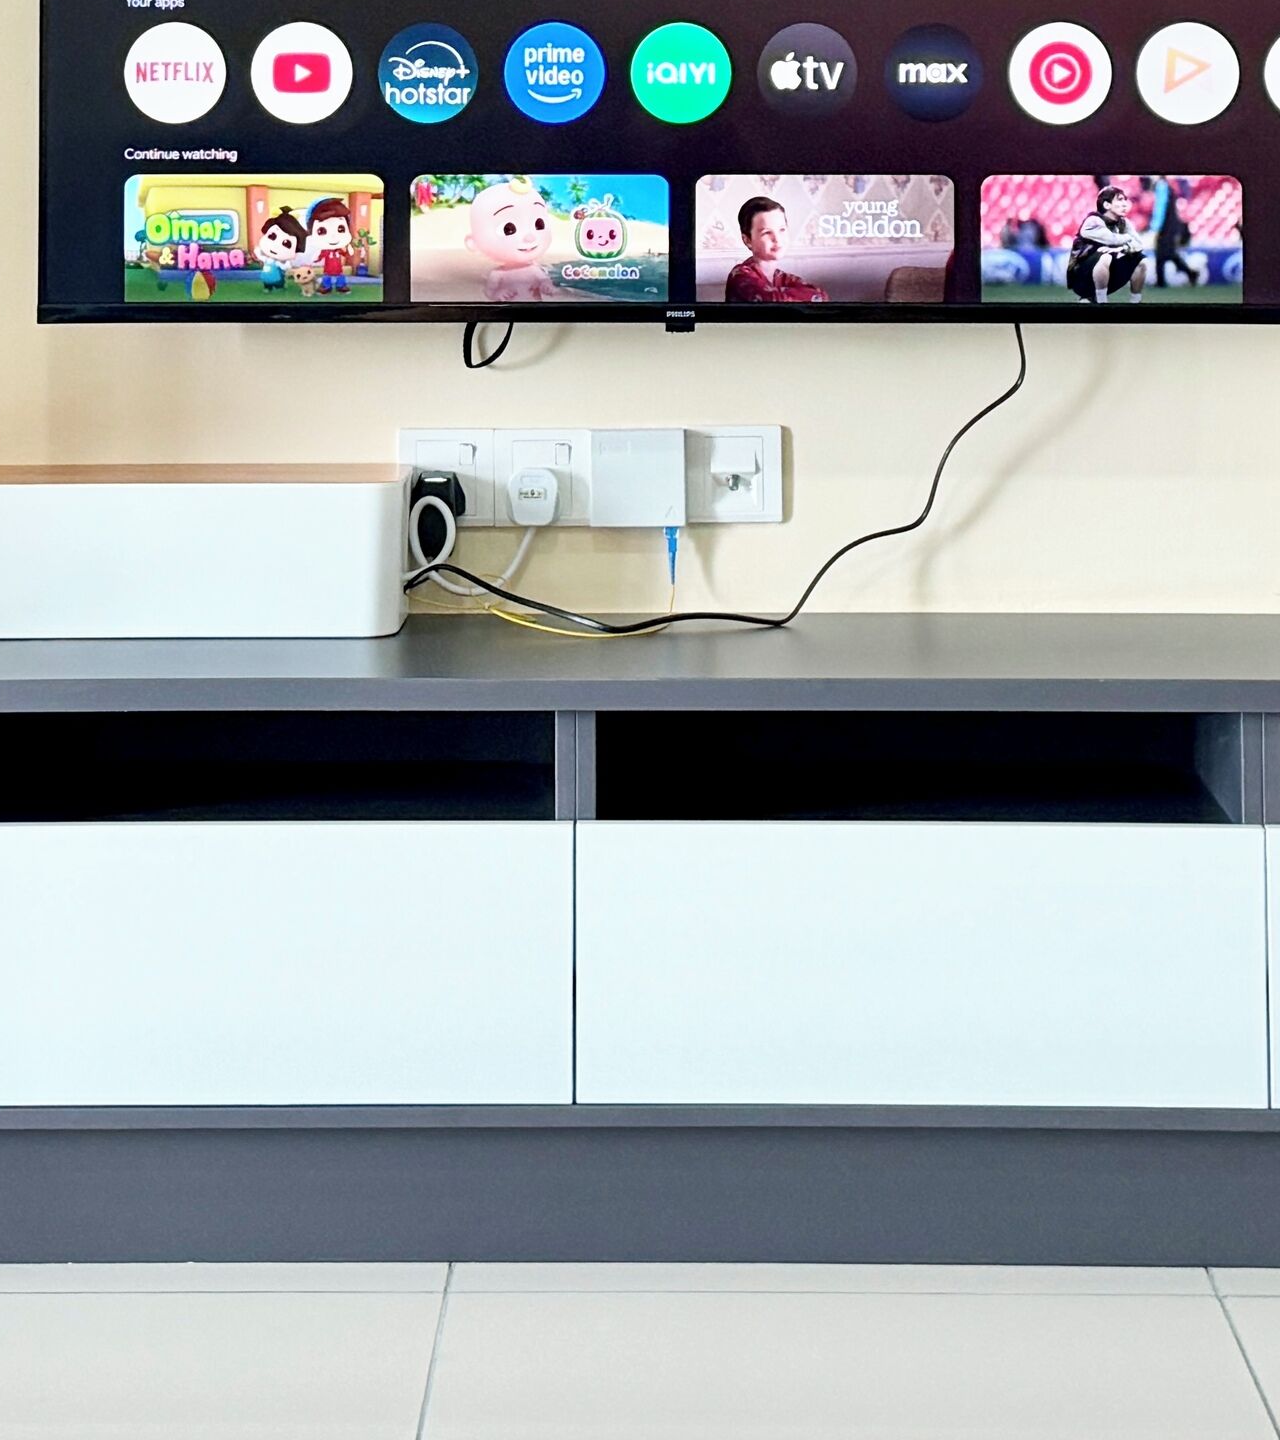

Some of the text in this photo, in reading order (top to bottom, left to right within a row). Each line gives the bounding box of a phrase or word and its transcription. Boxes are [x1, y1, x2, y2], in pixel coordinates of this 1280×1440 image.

[524, 42, 585, 67] prime
[135, 61, 214, 83] NETFLIX
[525, 65, 584, 86] video
[806, 55, 844, 91] tv
[898, 60, 968, 84] max
[385, 82, 471, 106] hotstar
[123, 147, 238, 163] Continue watching
[842, 198, 899, 218] young
[145, 213, 231, 245] Omar
[818, 214, 924, 239] Sheldon
[159, 242, 245, 271] & Hana
